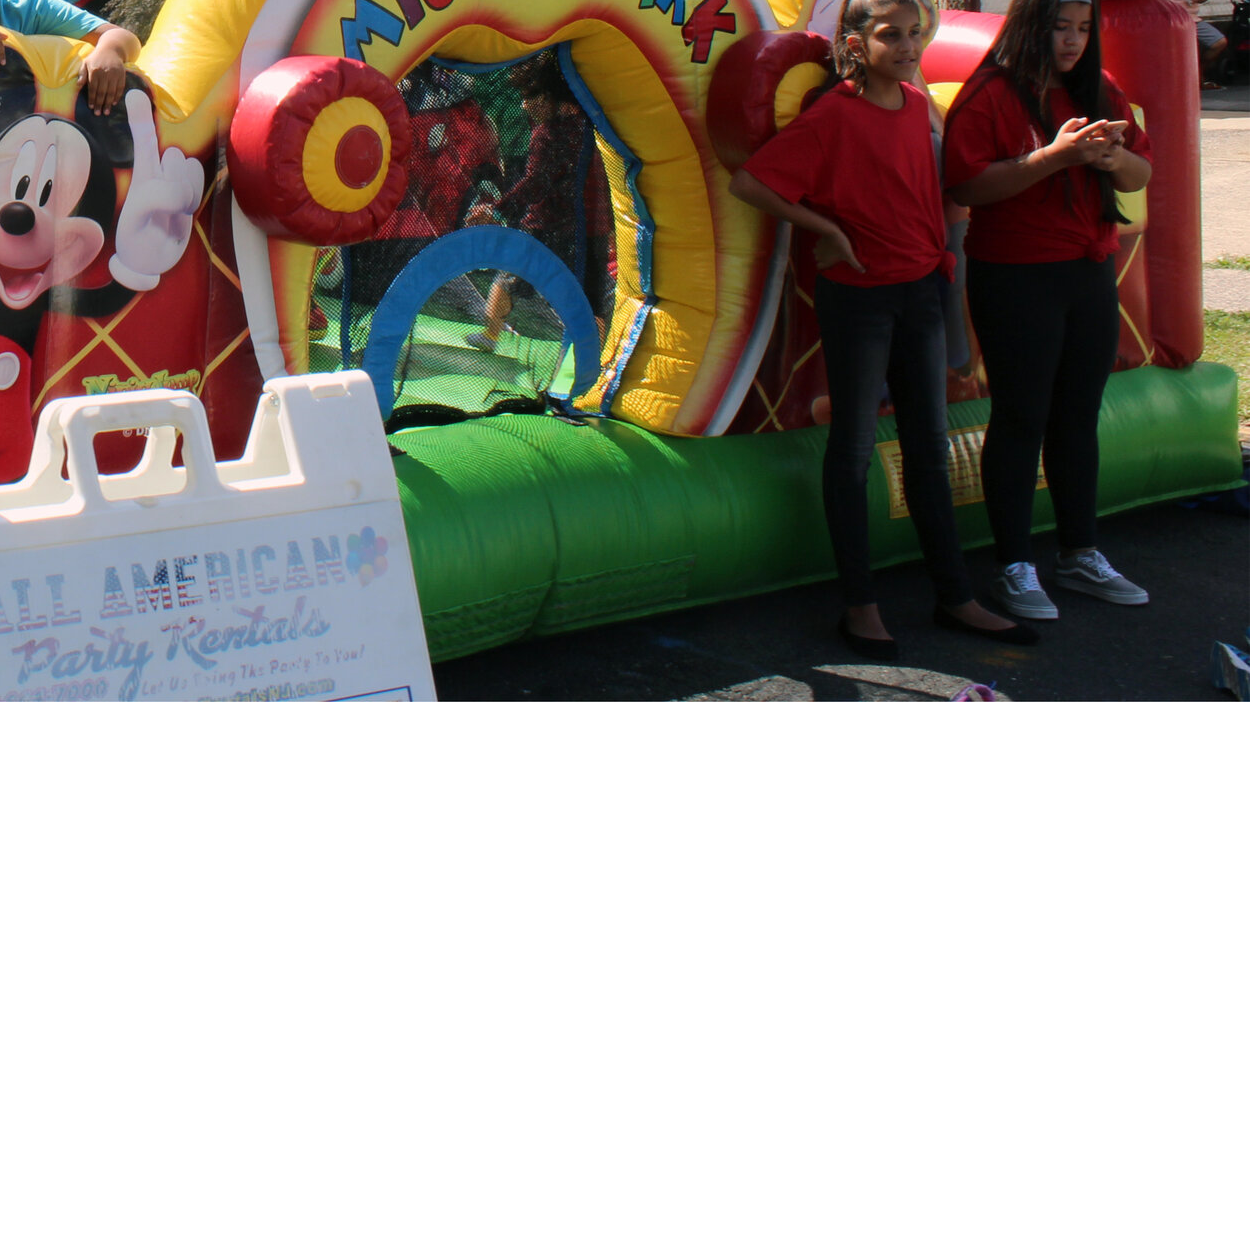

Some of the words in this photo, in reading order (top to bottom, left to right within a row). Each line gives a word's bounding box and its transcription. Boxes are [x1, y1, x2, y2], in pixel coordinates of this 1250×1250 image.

[100, 535, 346, 619] AMERICAN
[12, 627, 154, 701] Party
[160, 595, 331, 671] Rentals
